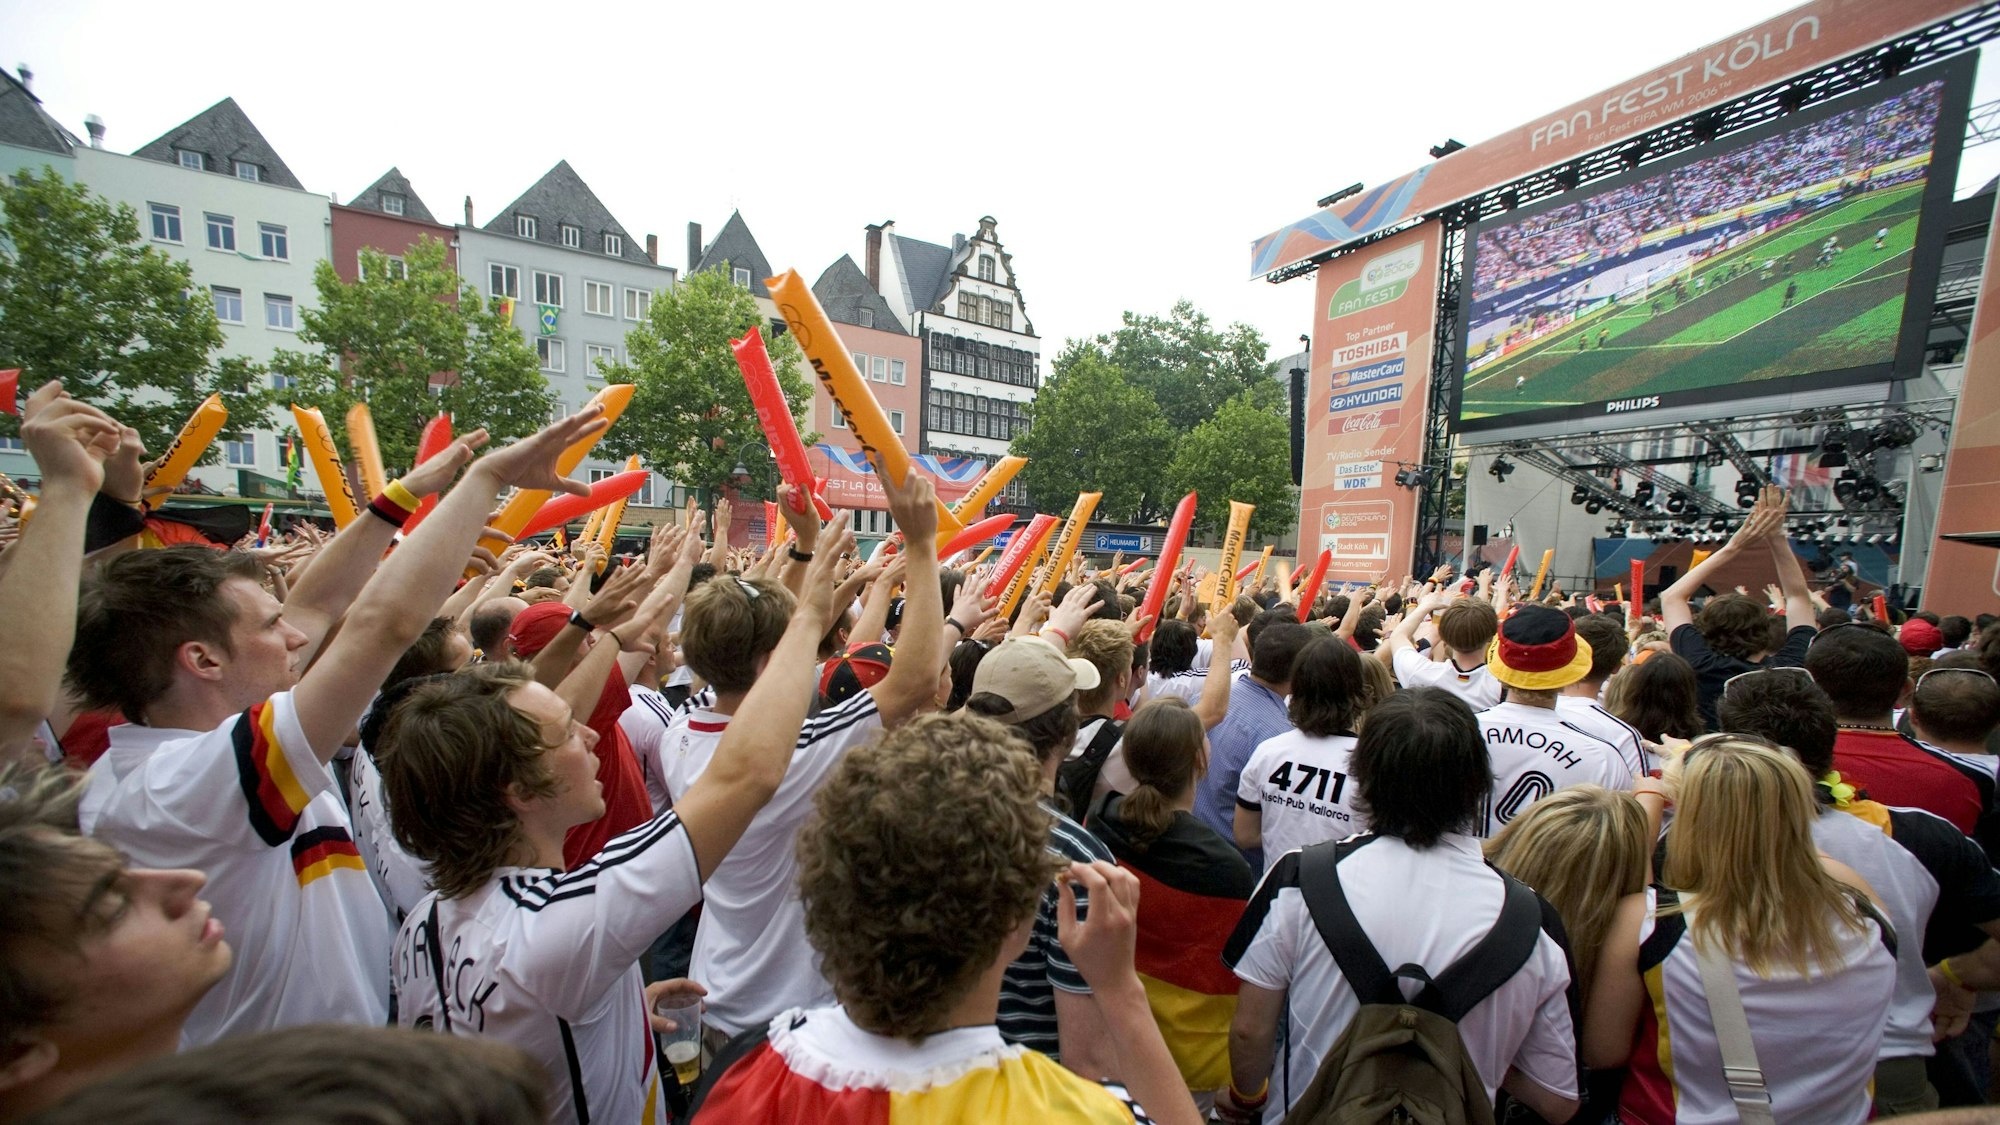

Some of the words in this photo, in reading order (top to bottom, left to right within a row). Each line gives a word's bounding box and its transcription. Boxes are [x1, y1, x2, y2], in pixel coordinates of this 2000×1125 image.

[1531, 110, 1592, 151] FAN
[1601, 65, 1693, 124] FEST
[1703, 15, 1820, 84] KÖLN
[1608, 120, 1631, 136] Fest
[1633, 109, 1658, 127] FIFA
[1660, 99, 1685, 117] WM
[1338, 297, 1361, 315] FAN
[1364, 285, 1397, 306] FEST
[1345, 332, 1361, 343] Top
[1362, 321, 1396, 337] Partner
[1338, 337, 1400, 363] TOSHIBA
[1350, 361, 1404, 383] MasterCard
[1346, 385, 1402, 407] HYUNDAI
[1606, 395, 1660, 413] PHILIPS
[811, 357, 879, 474] MasterC
[1326, 449, 1362, 461] TV/Radio
[1364, 445, 1397, 458] Sender
[1339, 465, 1353, 475] Das
[1354, 463, 1375, 474] Erste
[826, 478, 848, 490] EST
[849, 481, 864, 491] LA
[1343, 478, 1367, 489] WDR
[1043, 518, 1077, 583] MasterCard
[1109, 538, 1140, 547] HEUMARKT
[1354, 542, 1369, 550] Köln
[992, 530, 1034, 585] MasterCard
[1216, 529, 1242, 599] MasterCard
[1002, 548, 1034, 604] MasterCar
[1487, 727, 1582, 770] AMOAH
[1268, 761, 1347, 805] 4711
[1308, 801, 1351, 822] Mallorca
[403, 919, 499, 1033] BAACK
